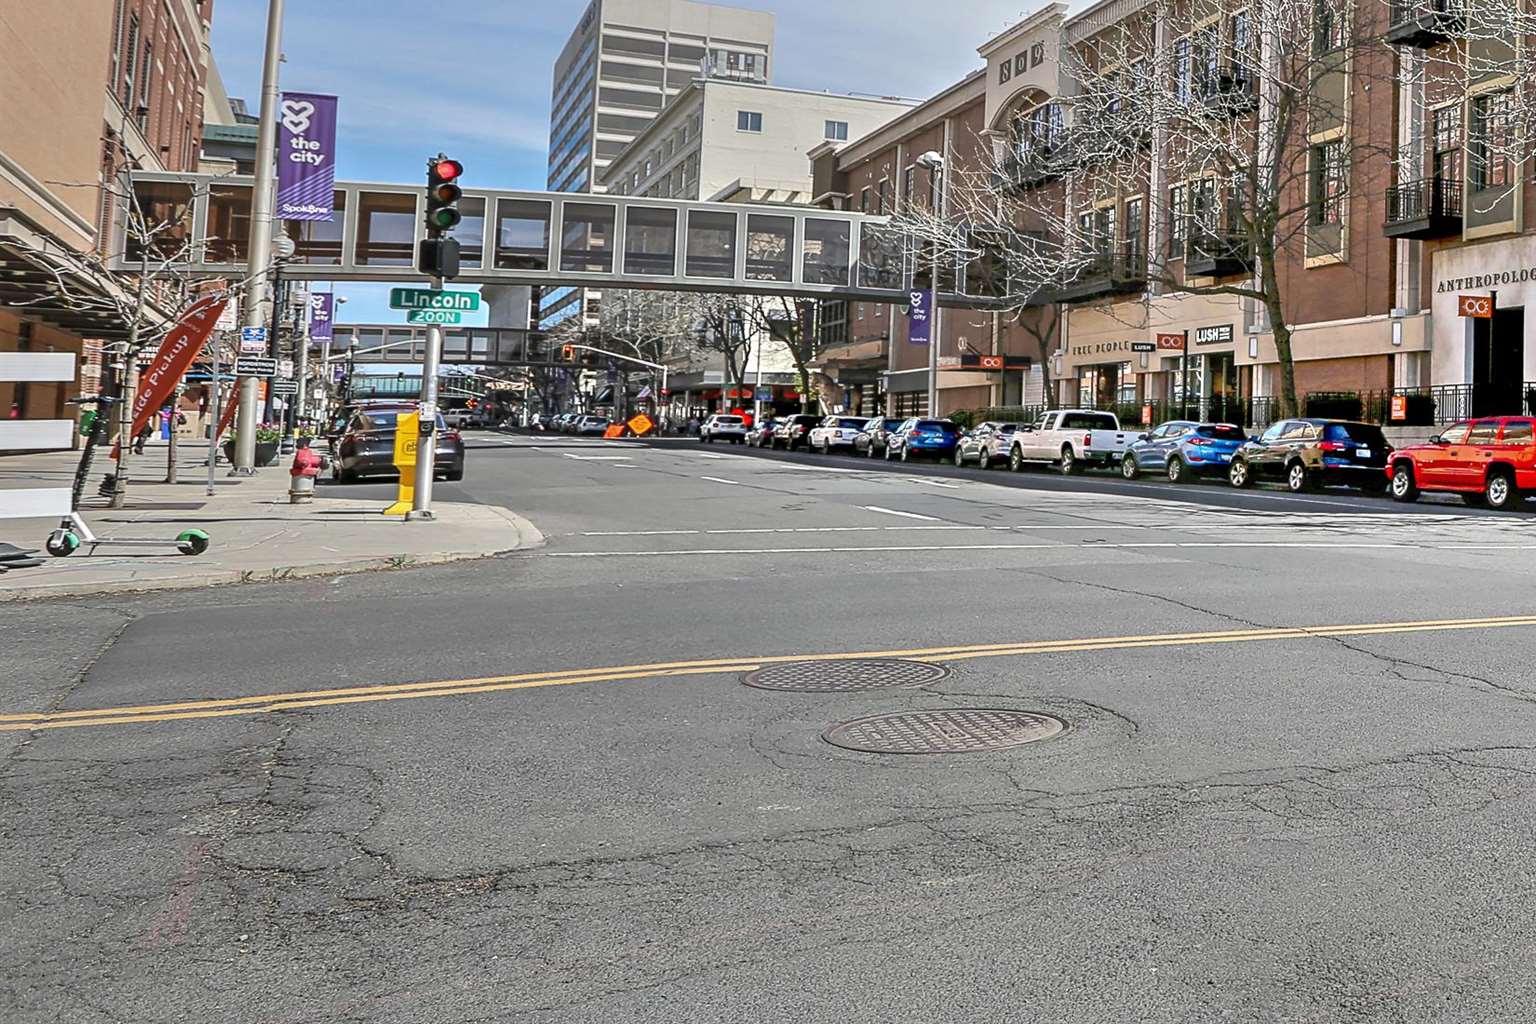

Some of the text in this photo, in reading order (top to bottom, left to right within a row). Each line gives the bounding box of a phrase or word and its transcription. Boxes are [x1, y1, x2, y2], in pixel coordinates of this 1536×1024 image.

[290, 137, 321, 150] the
[289, 150, 326, 166] city
[401, 290, 472, 309] Lincoln
[1196, 327, 1219, 343] LUSH
[1096, 340, 1129, 354] PEOPLE
[148, 334, 188, 386] Pickup
